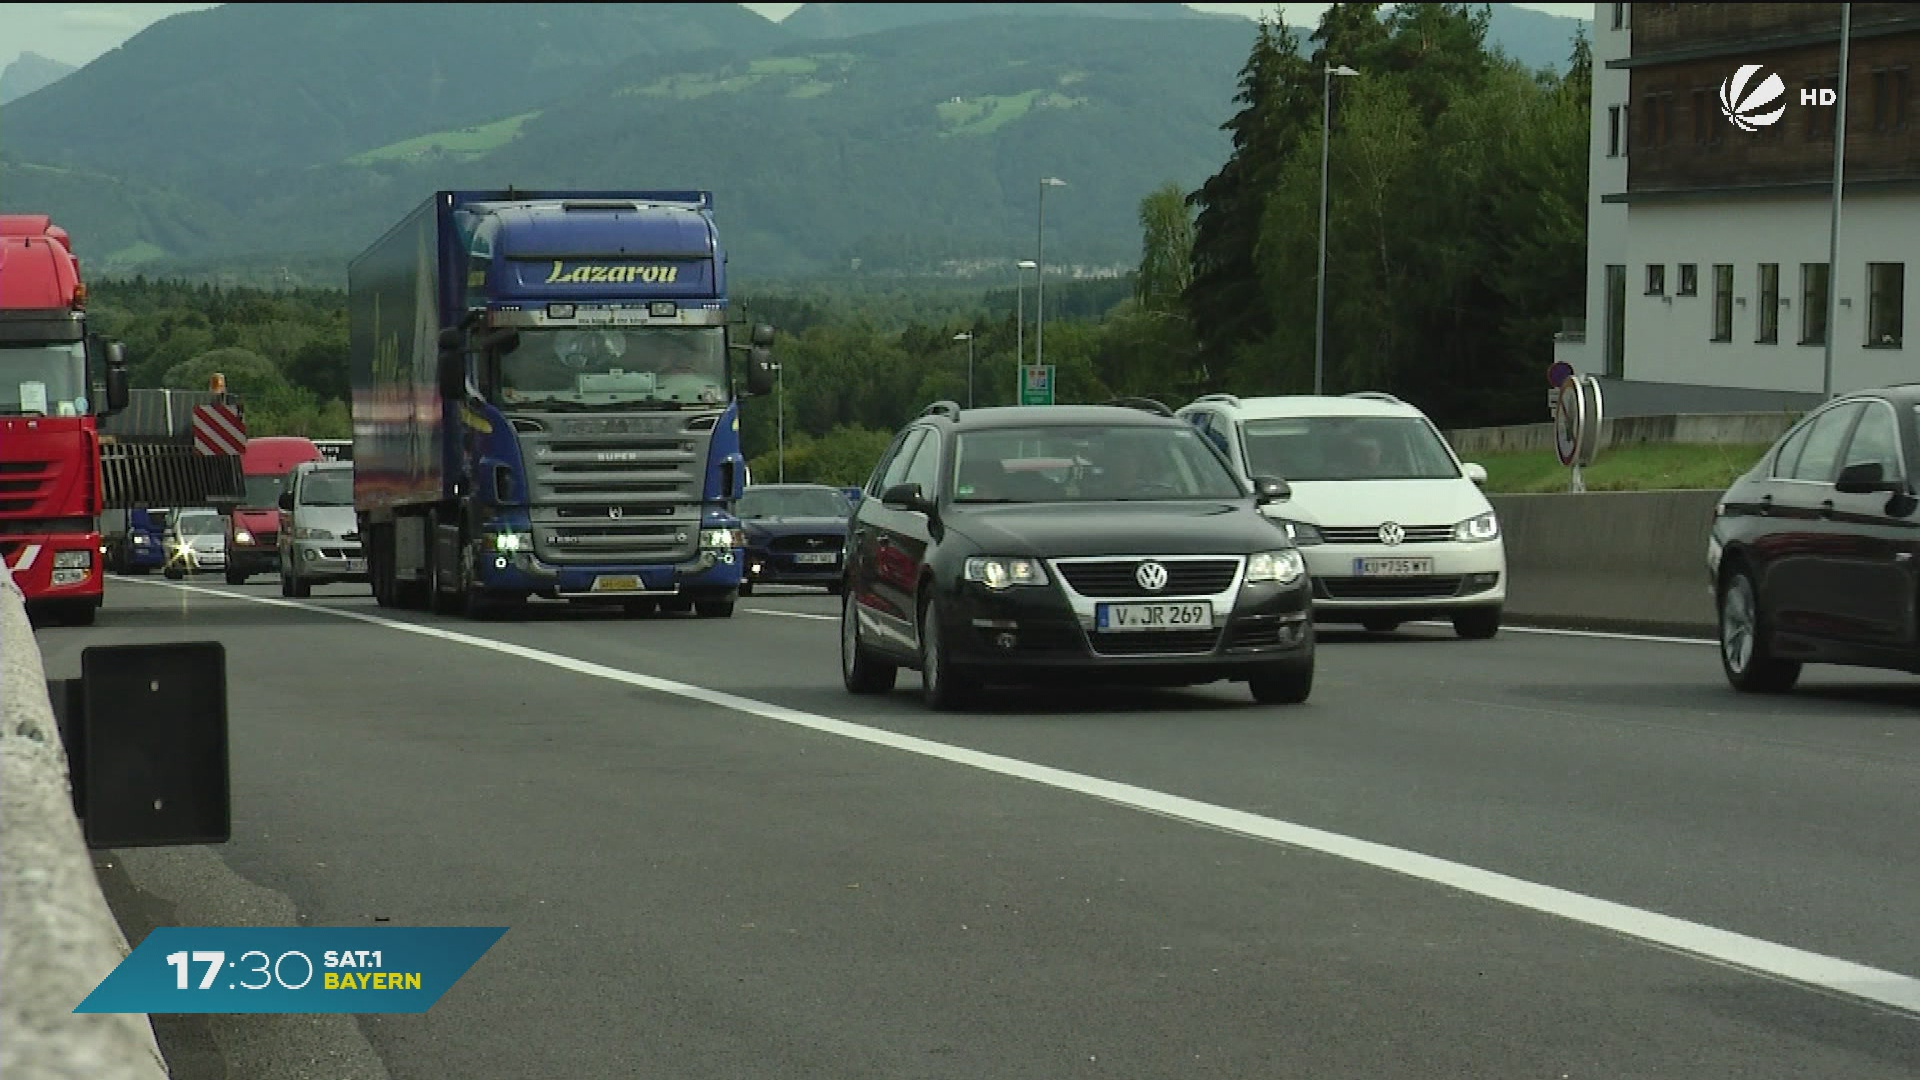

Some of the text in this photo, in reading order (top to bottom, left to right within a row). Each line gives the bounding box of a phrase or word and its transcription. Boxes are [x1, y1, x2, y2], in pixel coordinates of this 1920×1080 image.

[545, 260, 678, 283] Lazarou
[1141, 606, 1164, 624] JR
[1169, 606, 1203, 624] 269
